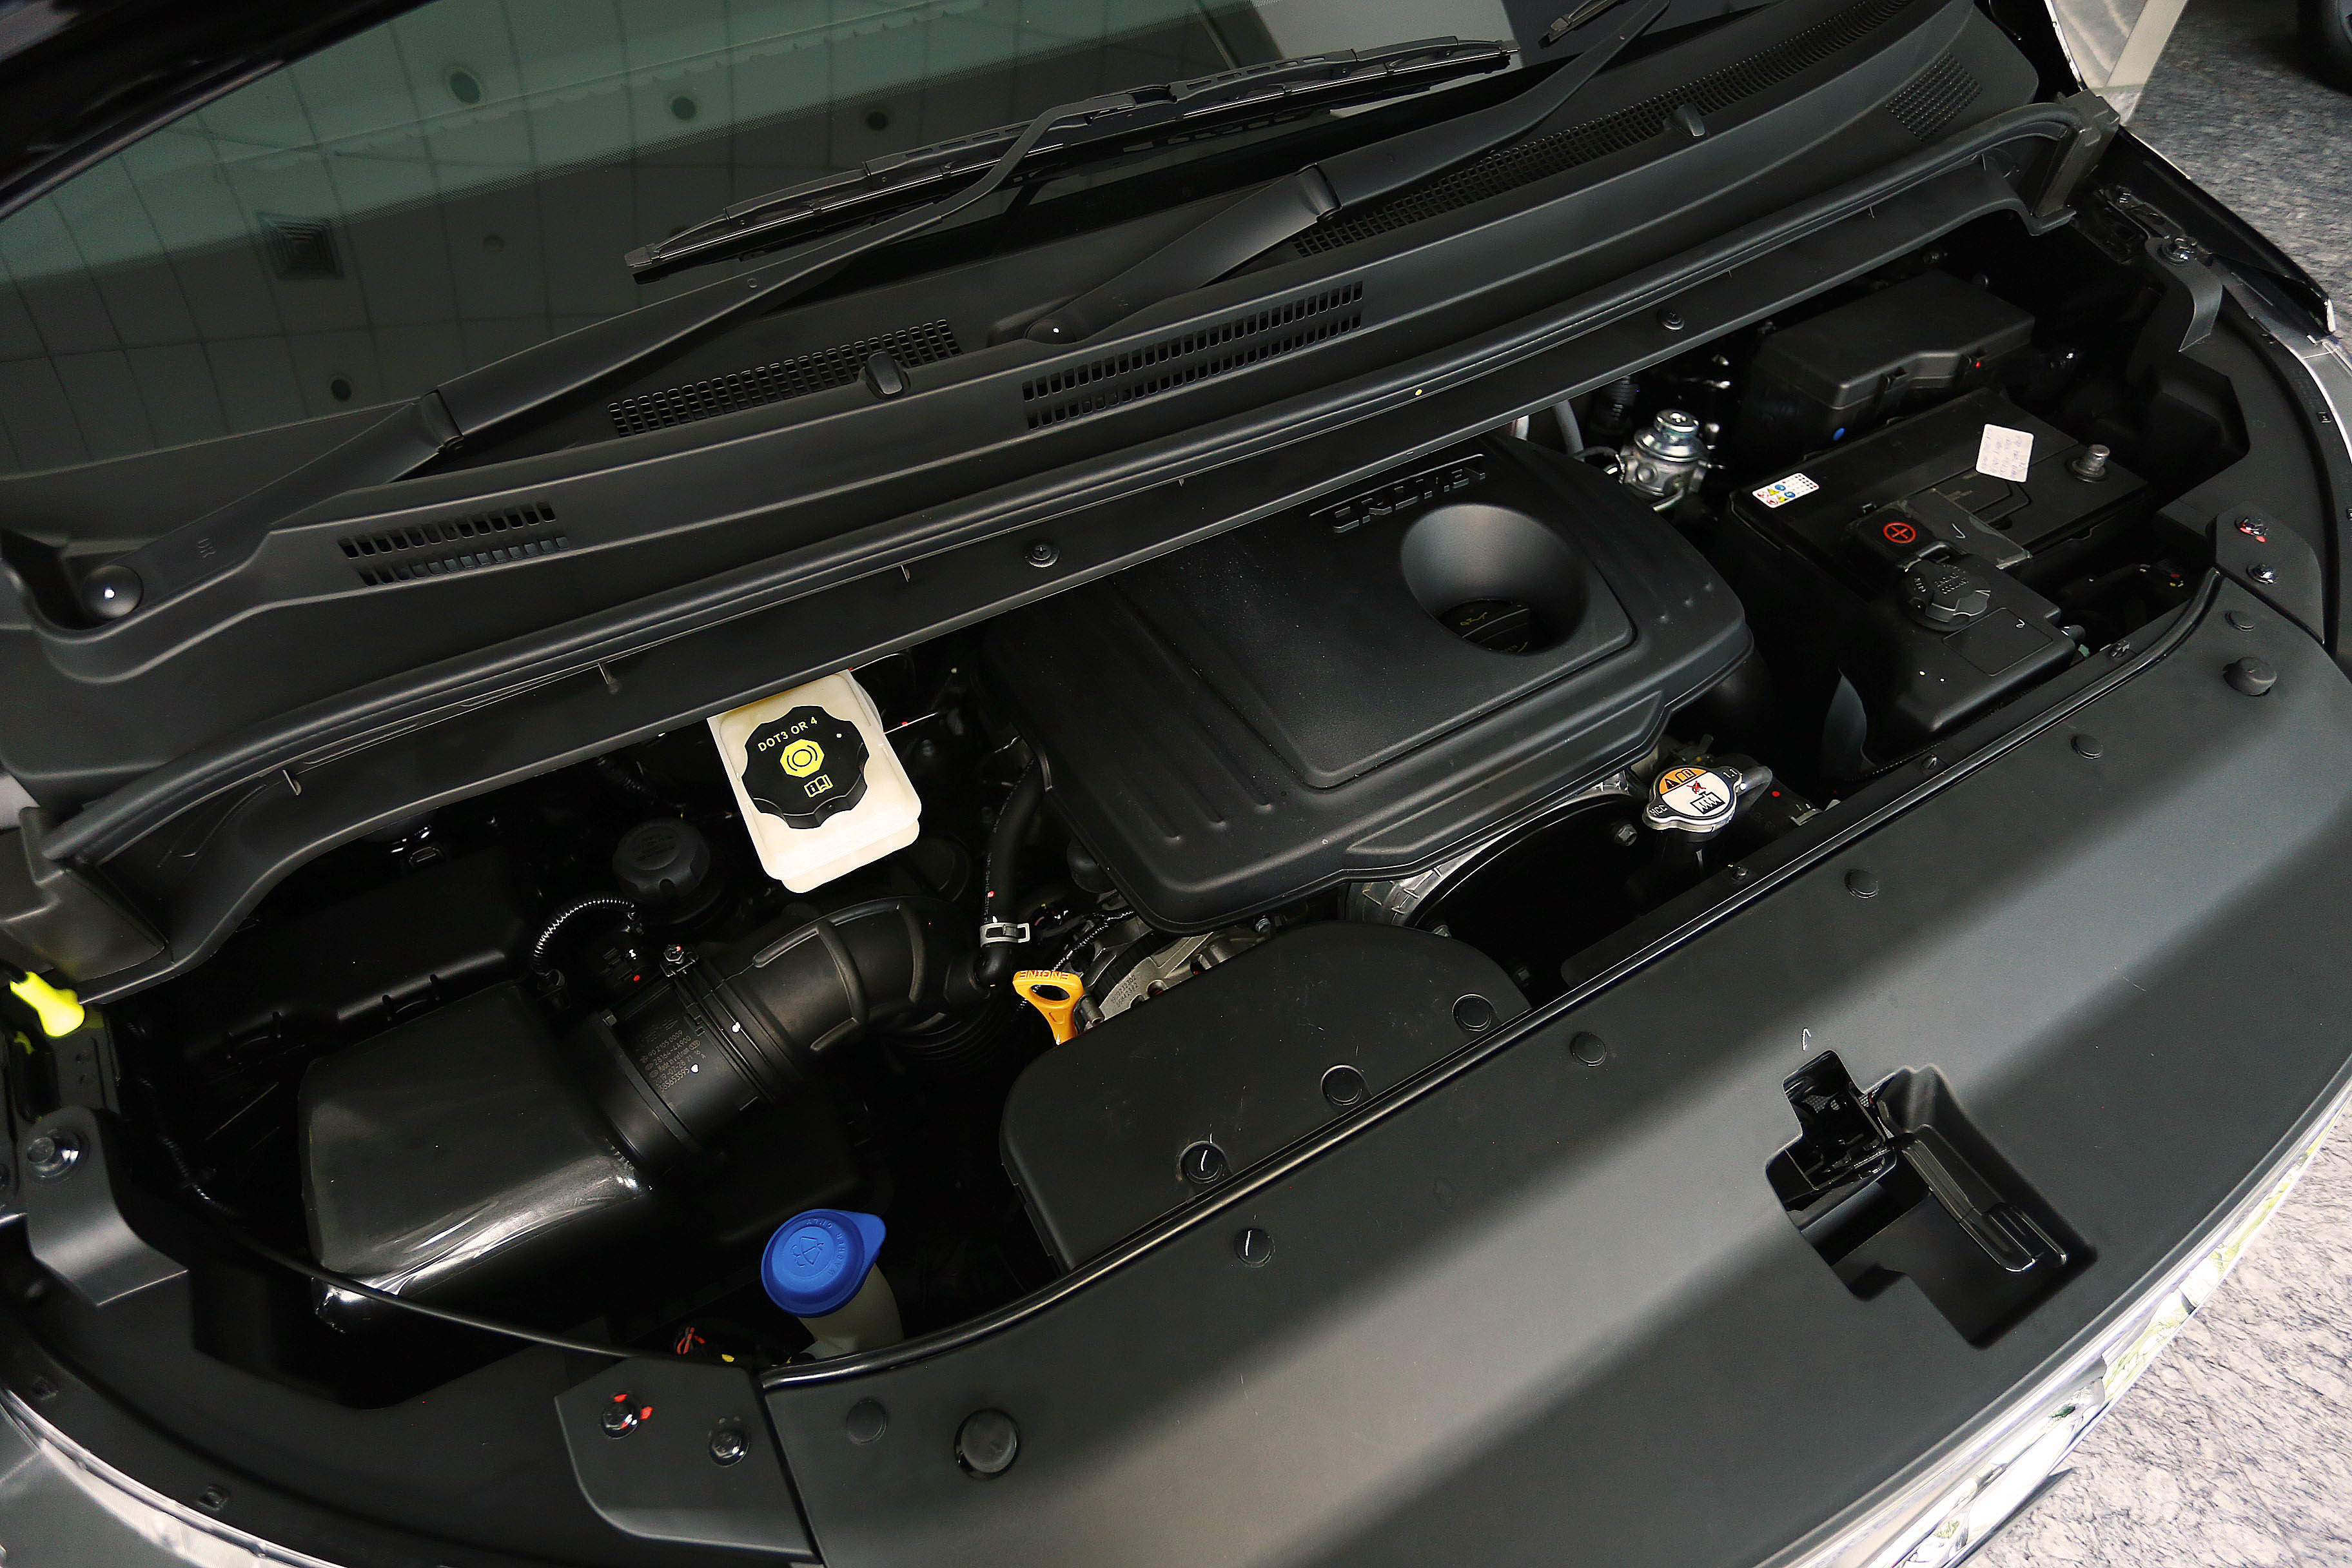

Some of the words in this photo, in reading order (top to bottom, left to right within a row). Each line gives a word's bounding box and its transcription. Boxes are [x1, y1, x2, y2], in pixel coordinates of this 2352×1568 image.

[758, 731, 789, 752] DOT3
[790, 721, 808, 734] OR
[810, 716, 818, 725] 4
[1723, 769, 1738, 778] 1.1
[1649, 805, 1668, 816] HCC
[1019, 970, 1069, 980] ENGINE
